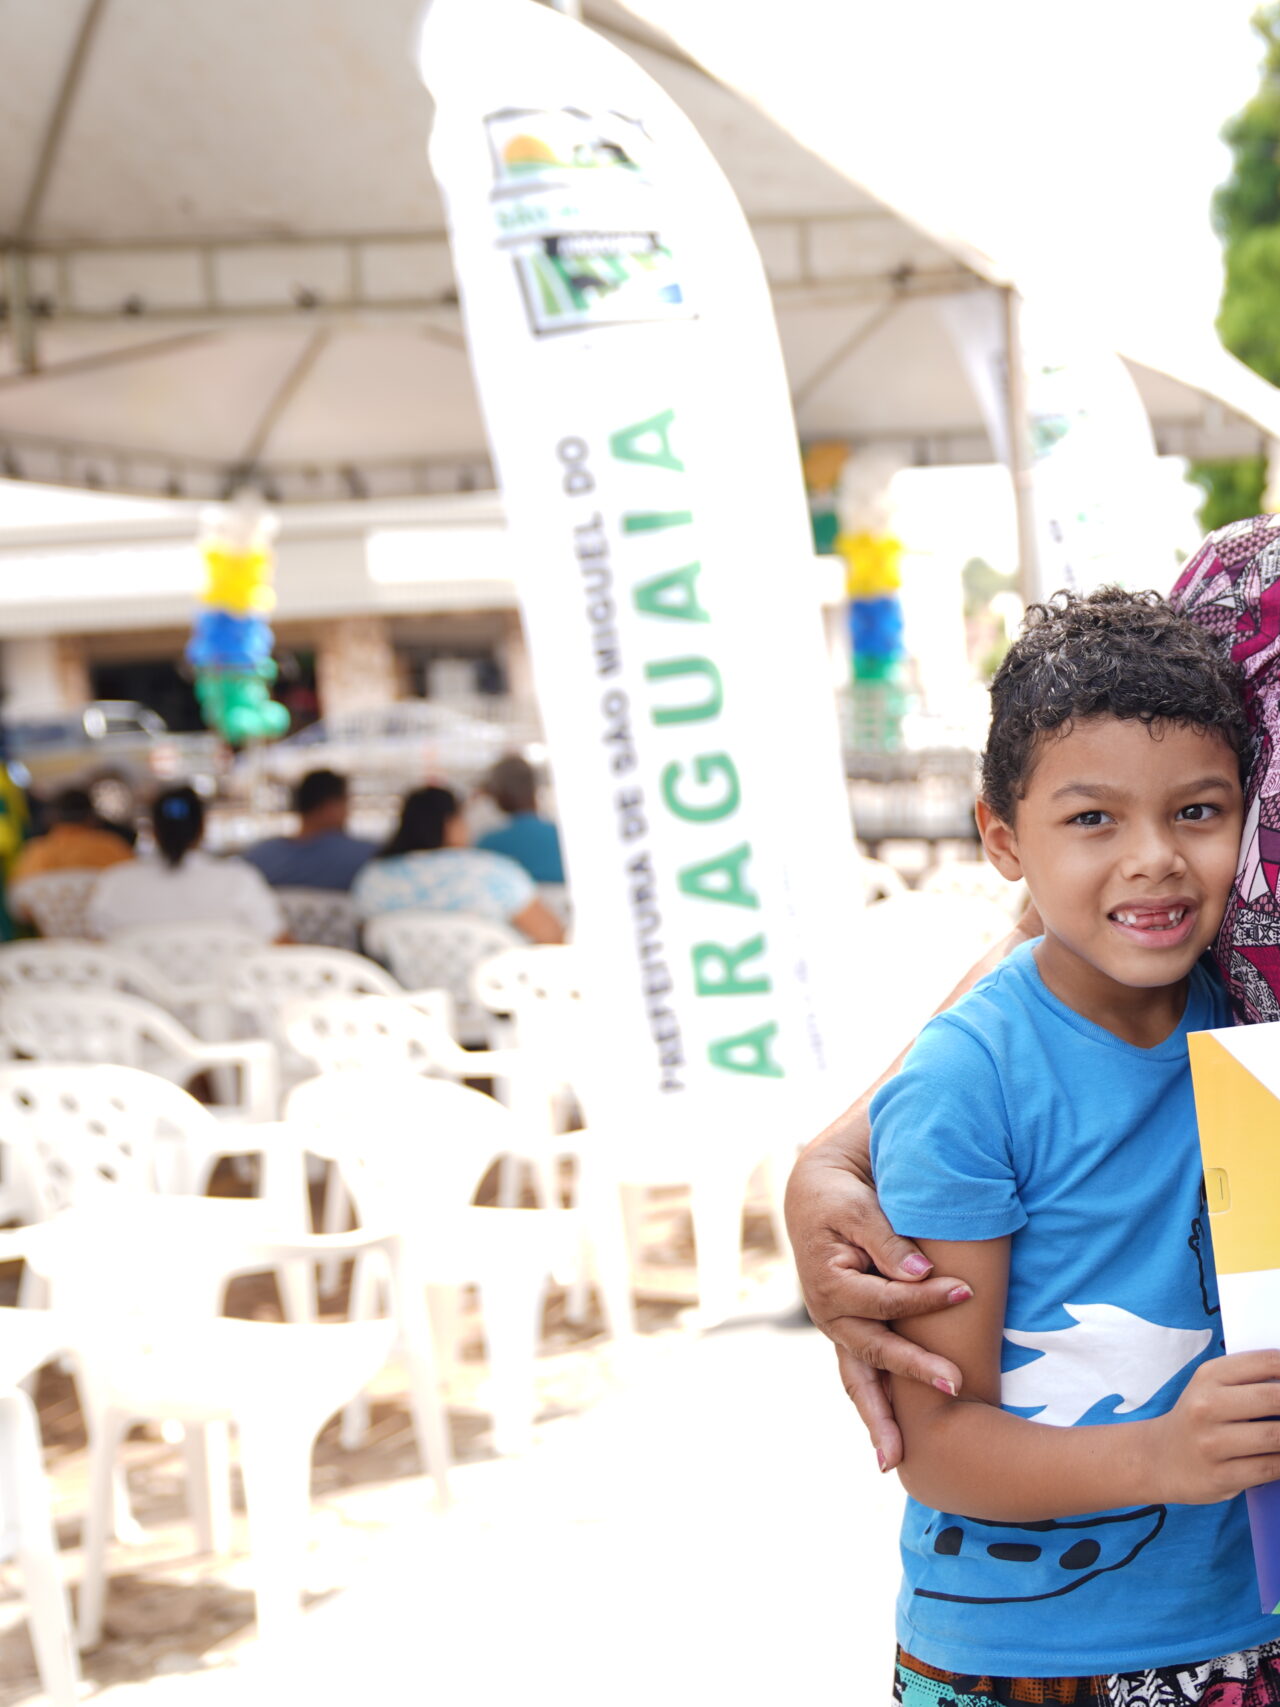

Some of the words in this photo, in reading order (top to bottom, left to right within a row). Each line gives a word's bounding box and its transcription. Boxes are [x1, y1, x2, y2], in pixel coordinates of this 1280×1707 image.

[556, 435, 598, 497] DO
[572, 513, 622, 677] MIGUEL
[598, 690, 641, 777] SÃO
[609, 408, 785, 1080] ARAGUAIA
[614, 788, 649, 841] DE
[623, 854, 686, 1093] PREFEITURA
